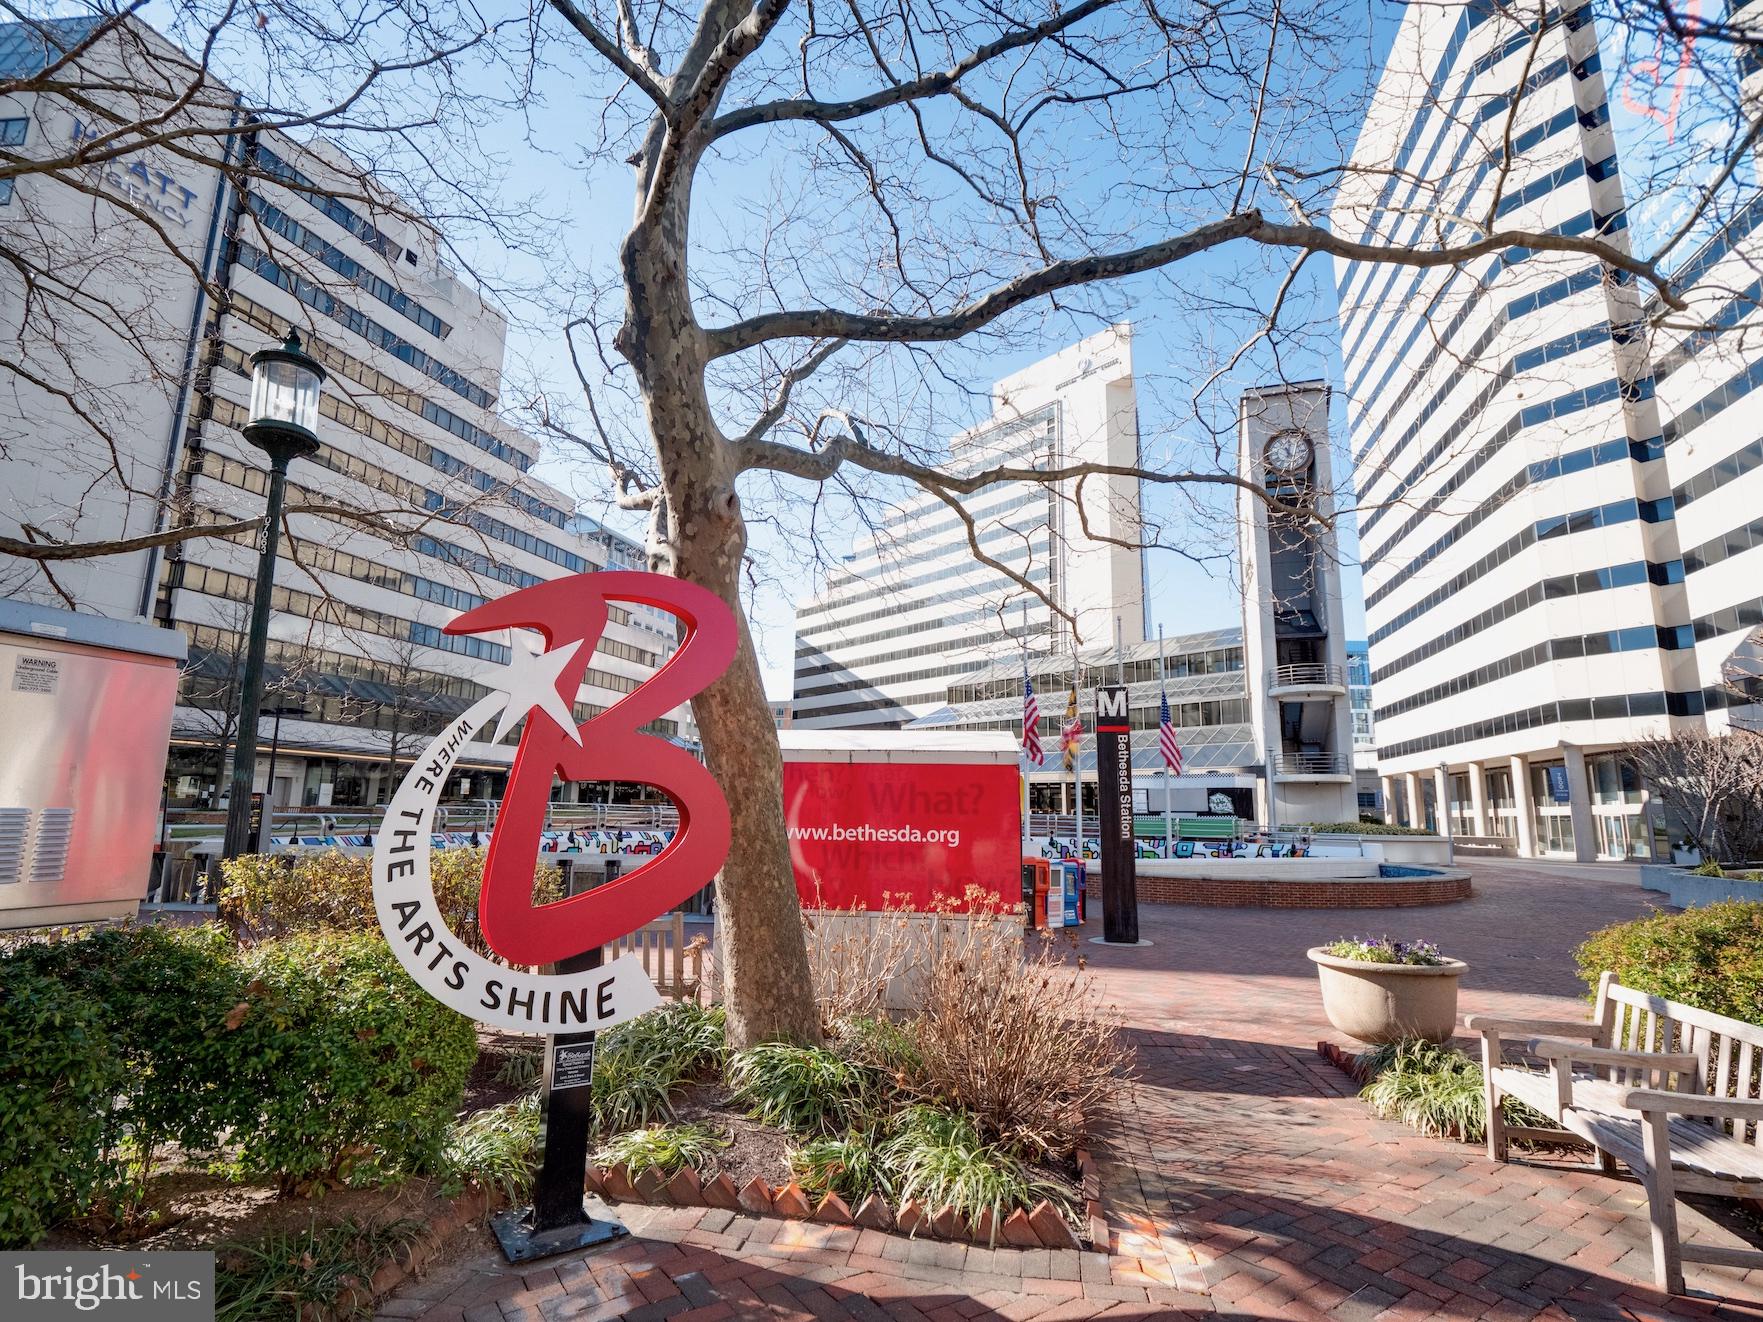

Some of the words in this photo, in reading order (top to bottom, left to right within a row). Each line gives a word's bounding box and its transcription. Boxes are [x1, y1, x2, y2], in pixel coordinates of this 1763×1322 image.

[261, 516, 271, 555] 07063
[22, 657, 56, 668] WARNING
[1098, 690, 1127, 717] M
[414, 719, 473, 795] WHERE
[1117, 734, 1131, 792] Bethesda
[867, 783, 985, 815] What?
[1120, 795, 1132, 839] Station
[387, 807, 424, 883] THE
[391, 900, 470, 990] ARTS
[480, 976, 616, 1025] SHINE
